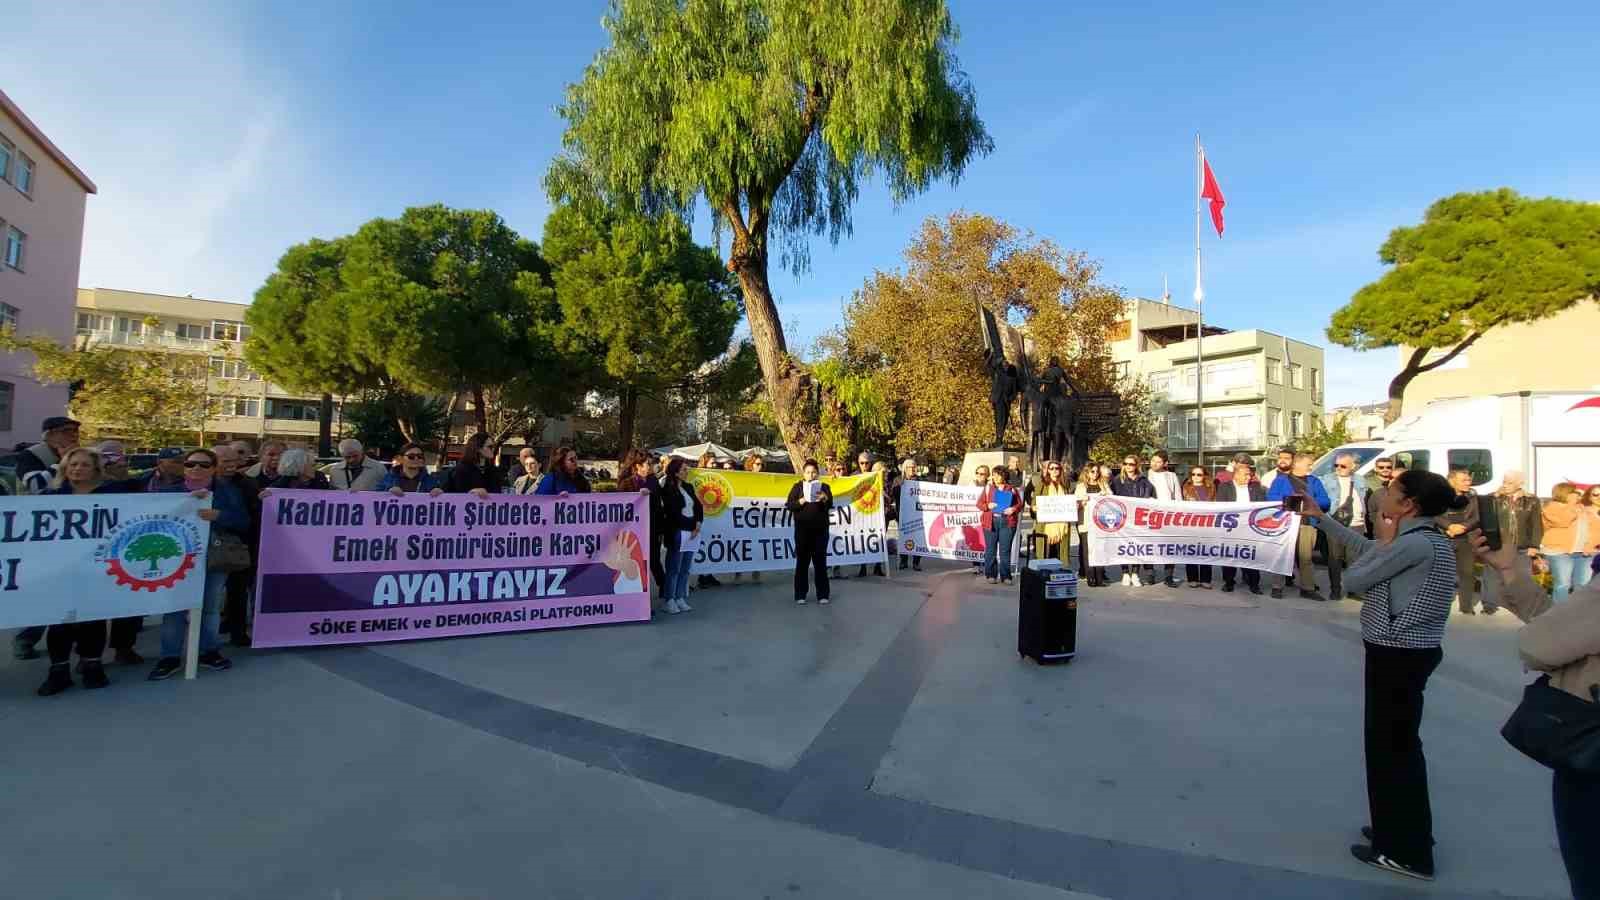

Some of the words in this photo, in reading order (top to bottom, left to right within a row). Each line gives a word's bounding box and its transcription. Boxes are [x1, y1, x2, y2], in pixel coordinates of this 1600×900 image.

[966, 492, 977, 501] YA
[1, 503, 120, 543] LERİN
[277, 498, 362, 526] Kadına
[373, 499, 457, 526] Yönelik
[463, 500, 548, 531] Şiddete,
[827, 504, 852, 525] EN
[946, 512, 980, 526] Mücad
[332, 535, 399, 562] Emek
[405, 532, 544, 562] Sömürüsüne
[550, 532, 601, 560] Karşı
[694, 533, 753, 564] SÖKE
[758, 528, 885, 562] TECİLİĞİ
[1117, 542, 1154, 557] SÖKE
[1157, 542, 1257, 561] TEMSİLCİLİĞİ
[0, 557, 21, 592] I
[372, 567, 568, 606] AYAKTAYIZ
[308, 619, 357, 636] SÖKE
[360, 617, 408, 634] EMEK
[412, 618, 432, 630] ve
[435, 607, 527, 630] DEMOKRASİ
[530, 602, 615, 622] PLATFORMU
